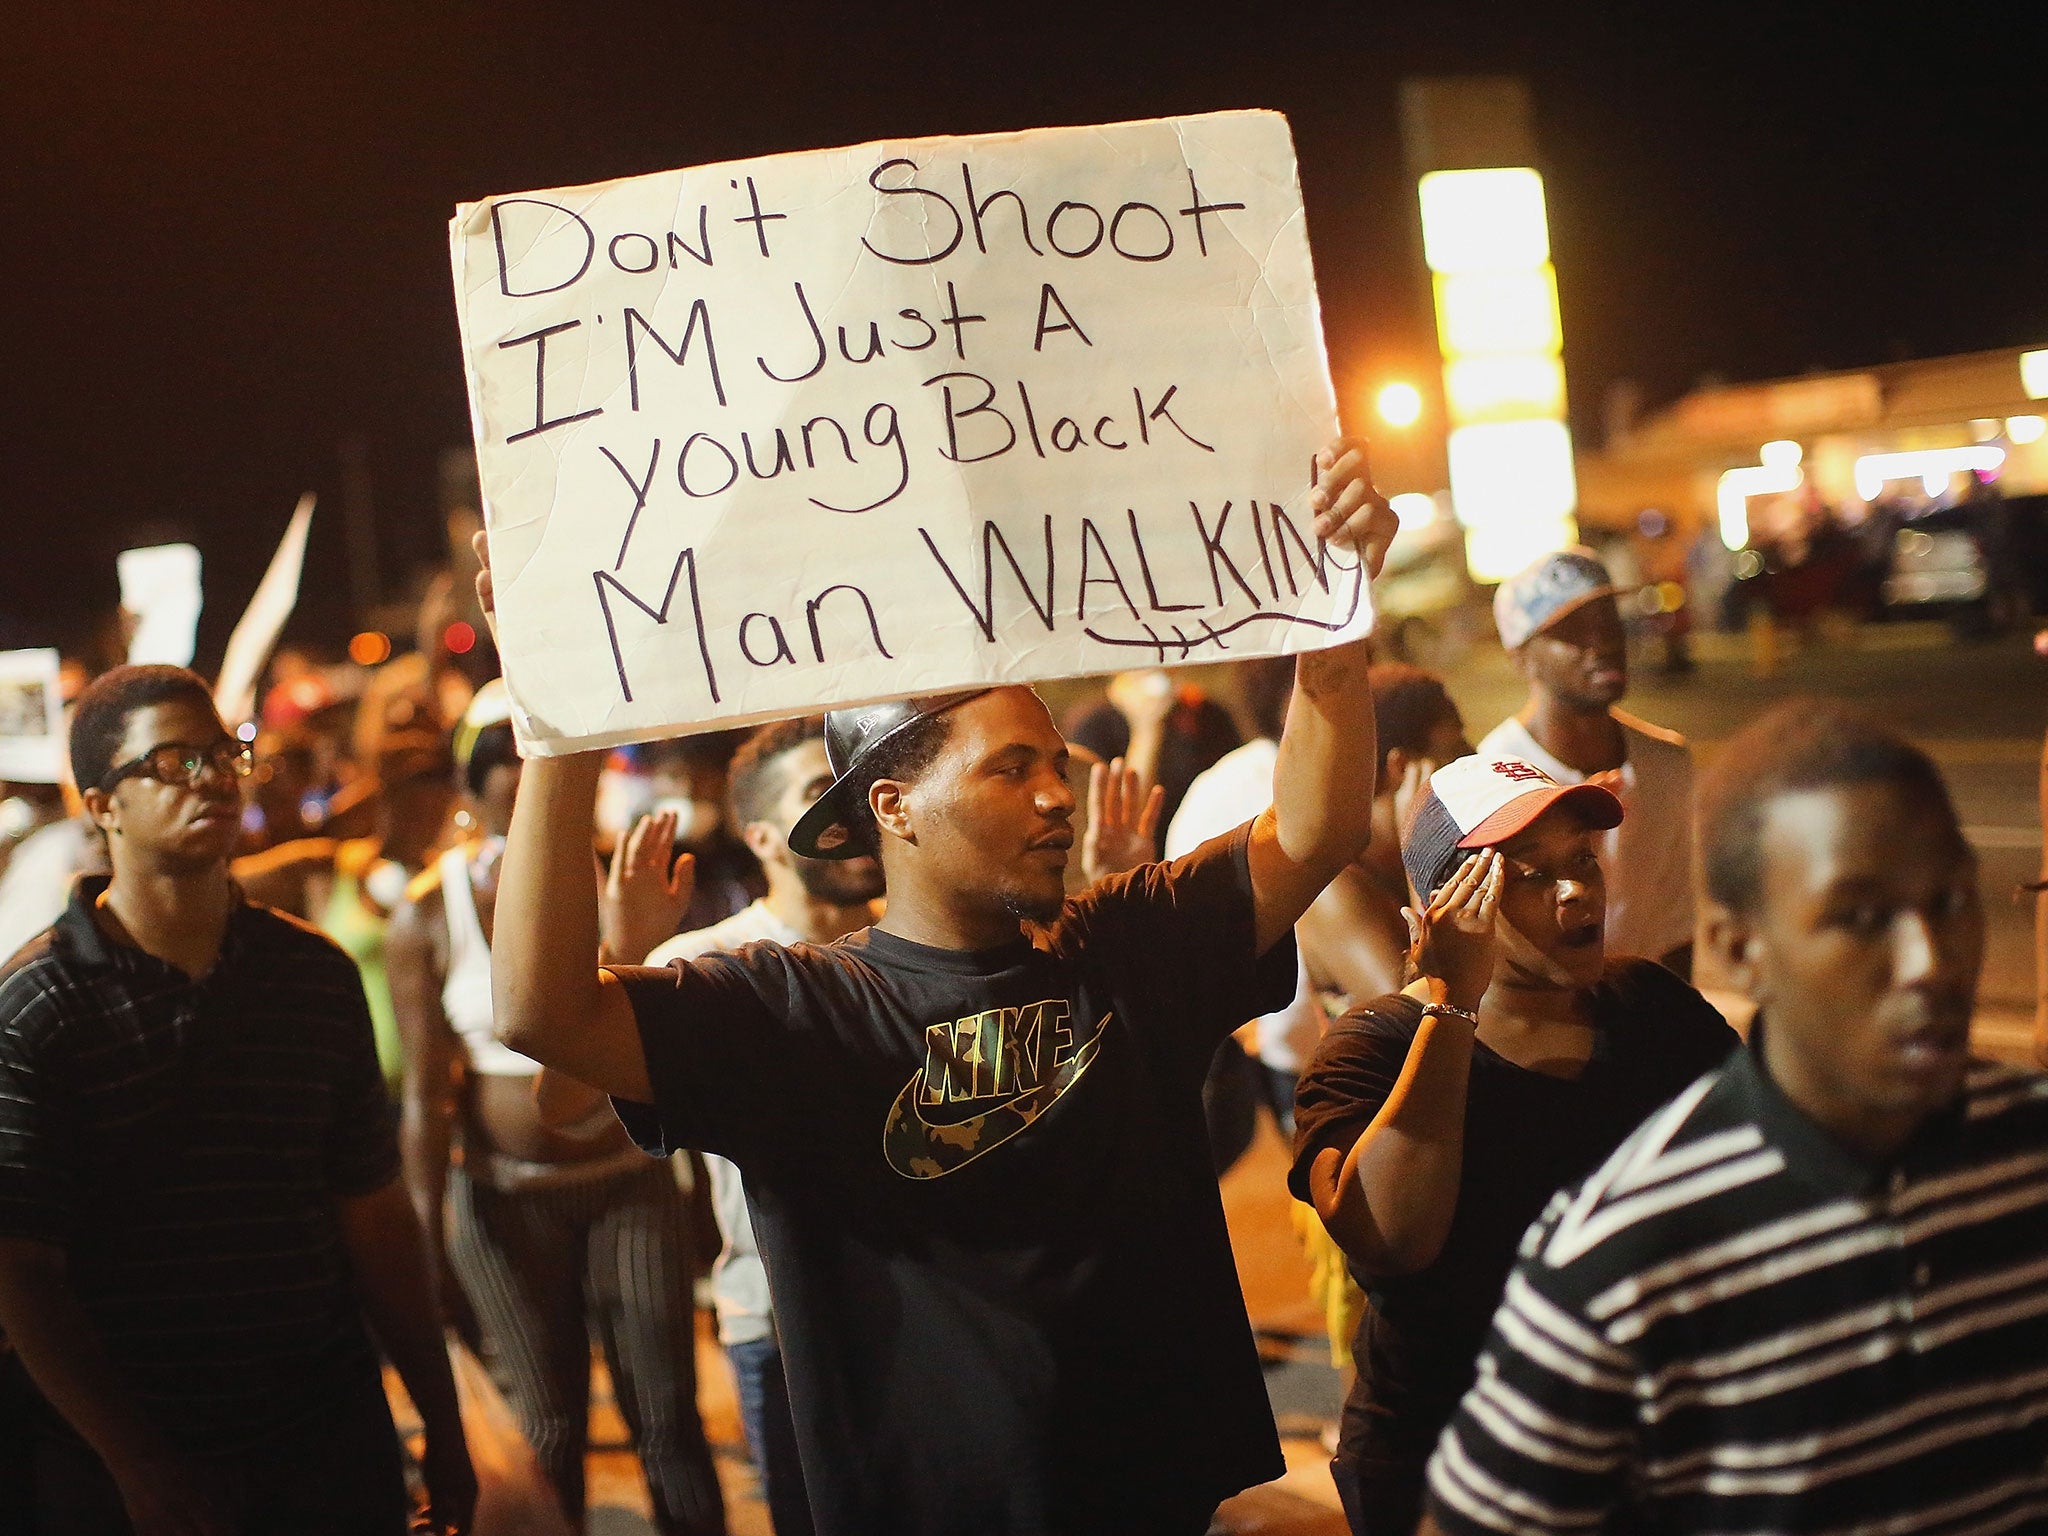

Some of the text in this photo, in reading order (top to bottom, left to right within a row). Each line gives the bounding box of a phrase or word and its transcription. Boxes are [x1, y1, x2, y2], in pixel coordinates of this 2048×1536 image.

[861, 159, 1245, 265] Shoot
[499, 282, 1092, 444] I'M Just A
[593, 548, 893, 703] Man
[920, 999, 1073, 1106] NIKE
